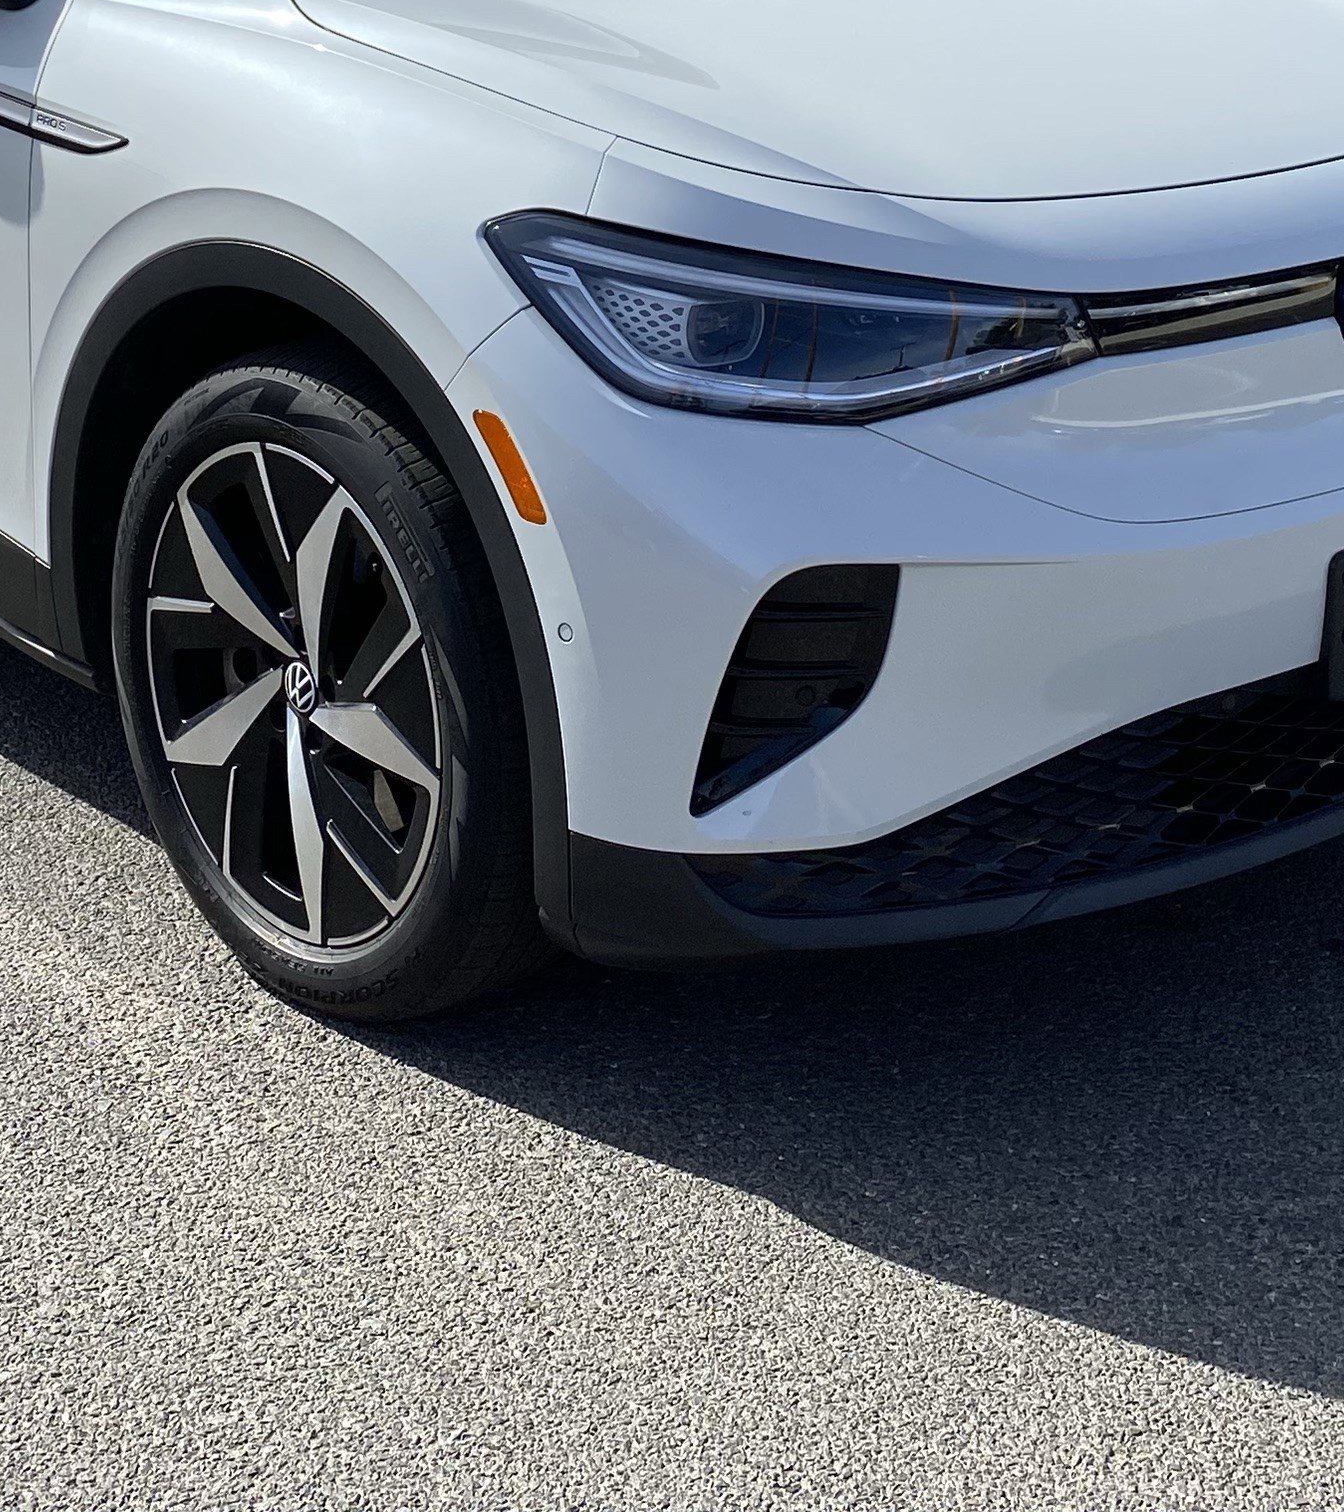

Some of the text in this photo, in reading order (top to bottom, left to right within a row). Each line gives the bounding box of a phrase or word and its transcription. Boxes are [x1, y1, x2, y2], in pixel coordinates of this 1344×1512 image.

[36, 114, 66, 131] PRO S
[374, 480, 435, 584] PIRELLI
[285, 661, 315, 713] VW
